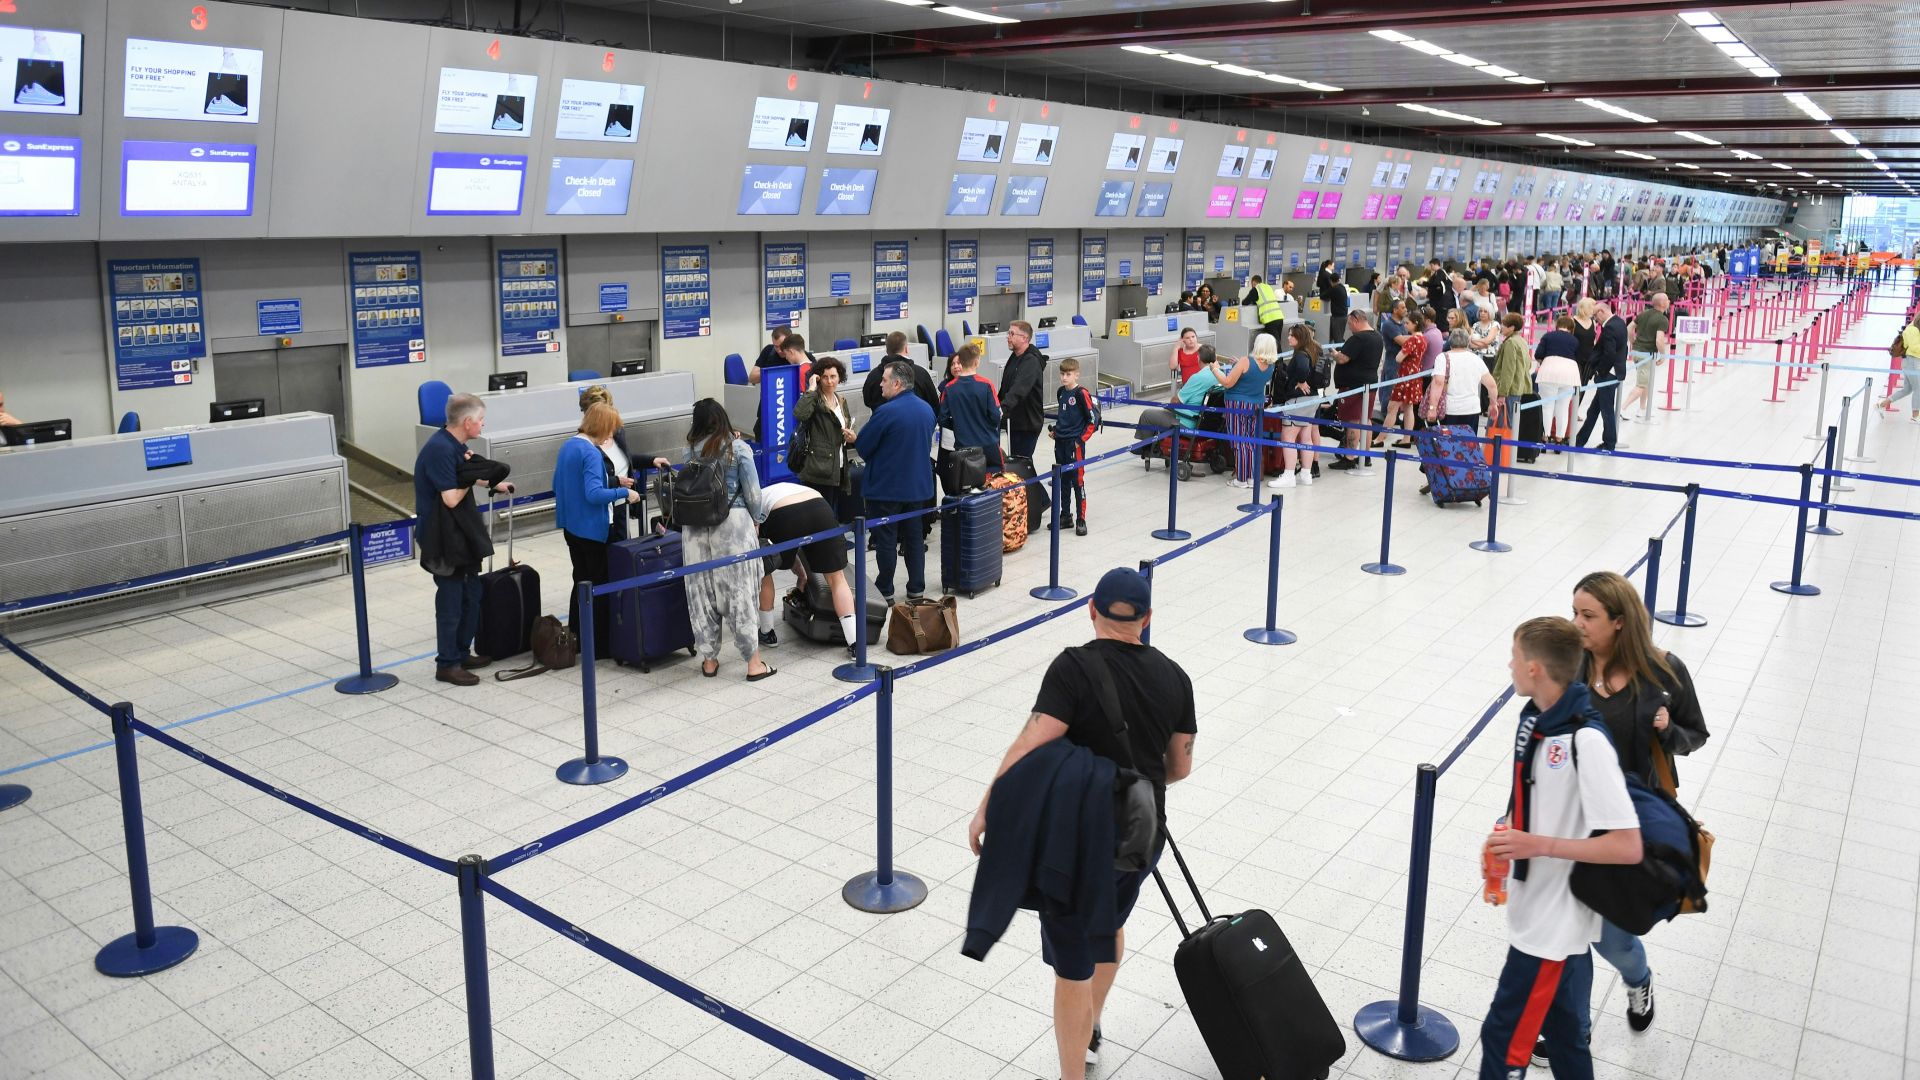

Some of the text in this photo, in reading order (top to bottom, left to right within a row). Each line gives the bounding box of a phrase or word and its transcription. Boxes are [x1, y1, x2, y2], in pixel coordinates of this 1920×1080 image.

[190, 6, 207, 30] 3
[487, 39, 500, 60] 4
[602, 52, 615, 72] 5
[164, 68, 196, 77] SHOPPING
[788, 73, 798, 91] 6
[863, 81, 872, 98] 7
[565, 176, 616, 186] Check-in Desk
[754, 180, 778, 189] Check-in
[578, 188, 601, 197] Closed
[763, 190, 781, 199] Closed
[371, 529, 396, 539] NOTICE
